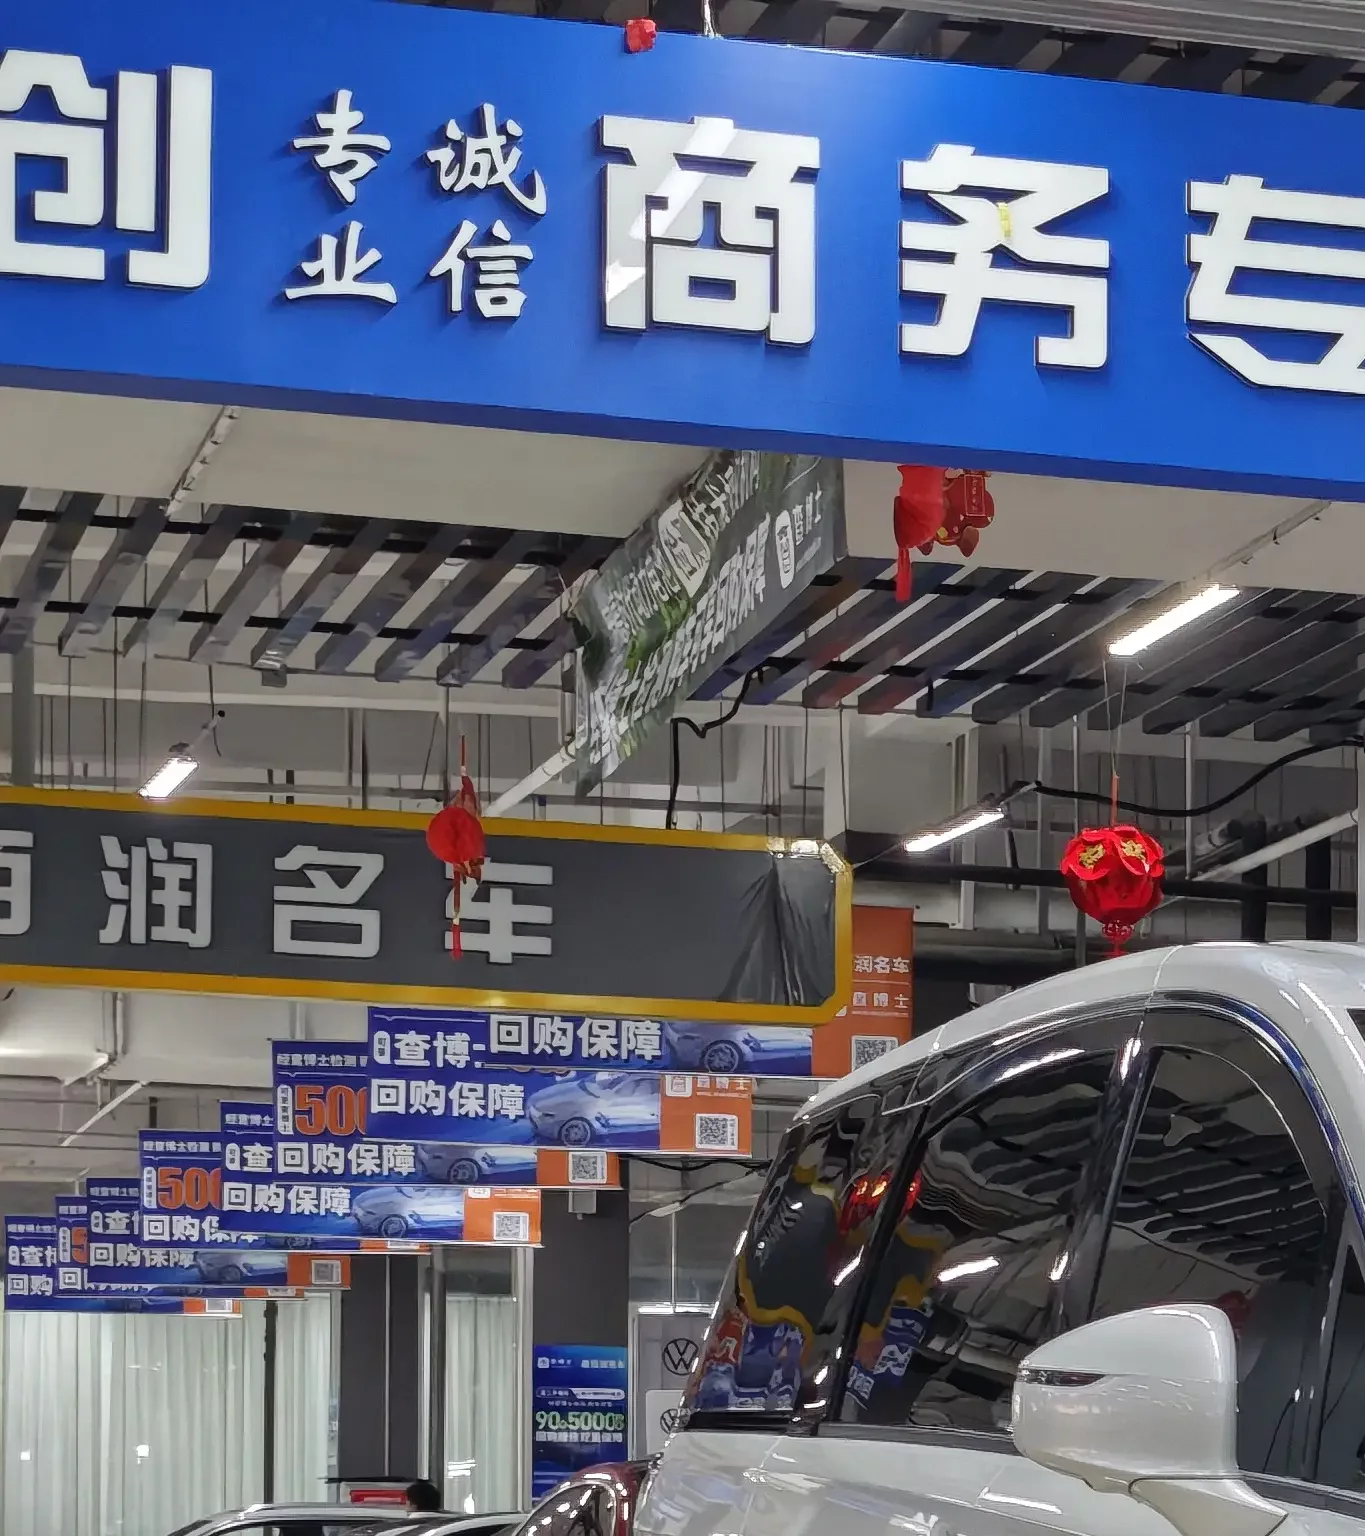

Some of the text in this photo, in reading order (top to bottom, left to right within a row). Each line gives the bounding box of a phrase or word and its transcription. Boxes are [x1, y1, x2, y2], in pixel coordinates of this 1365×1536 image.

[0, 48, 212, 288] 创
[490, 1014, 662, 1061] 回购保障
[371, 1079, 525, 1121] 回购保障
[277, 1142, 416, 1178] 回购保障
[223, 1182, 351, 1216] 回购保障
